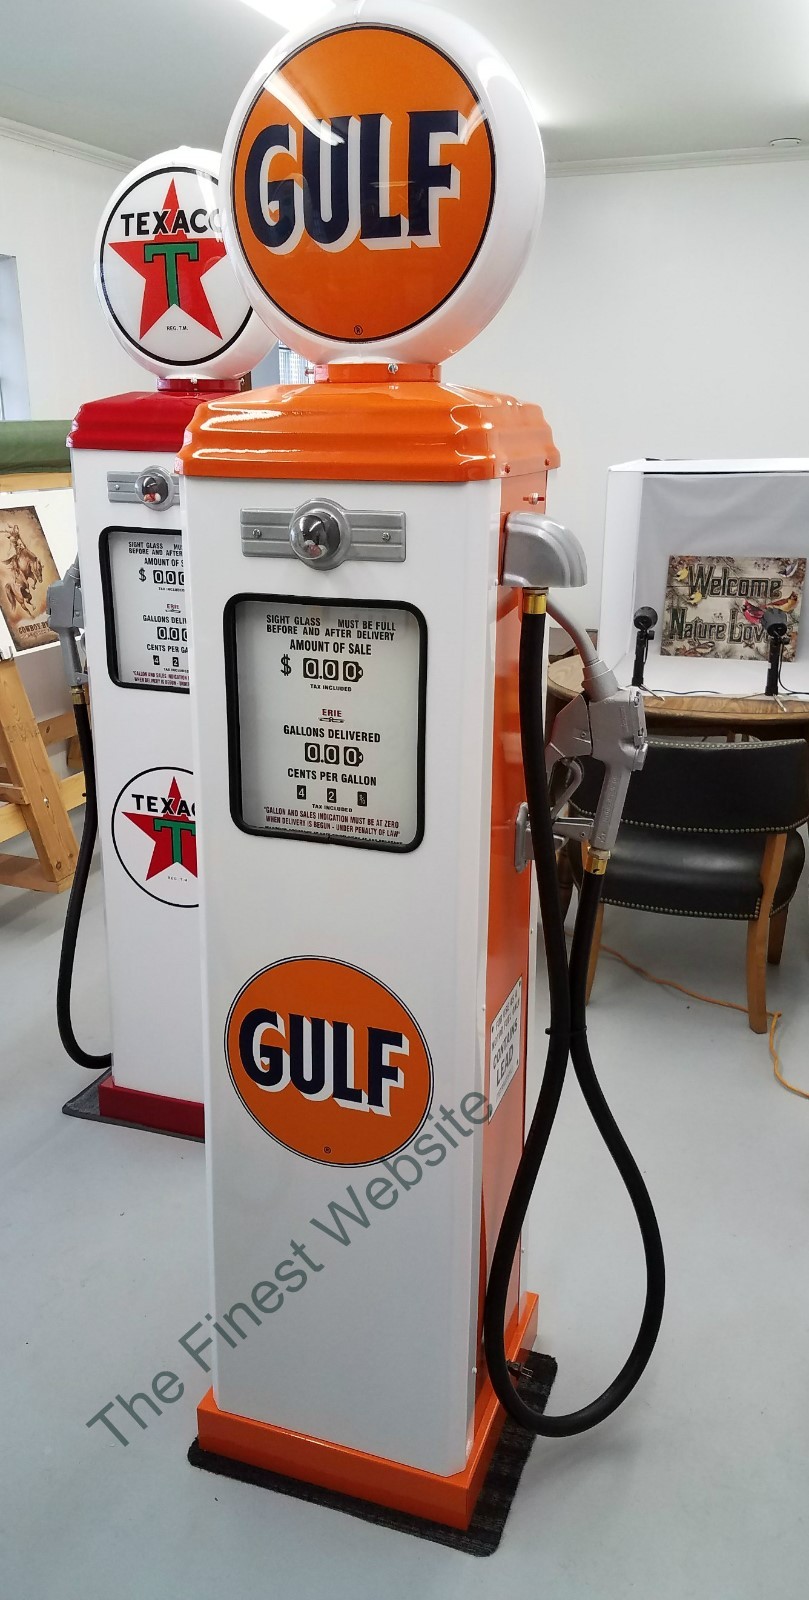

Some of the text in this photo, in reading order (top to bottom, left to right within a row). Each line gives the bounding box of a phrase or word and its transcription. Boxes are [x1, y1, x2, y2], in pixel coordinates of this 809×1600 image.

[245, 110, 467, 255] GULF
[144, 558, 169, 566] AMOUNT
[139, 567, 146, 582] $
[688, 564, 784, 599] Welcome
[143, 615, 169, 623] GALLONS
[266, 614, 396, 631] SIGHT GLASS MUST BE FULL
[670, 607, 771, 644] Nature Lov
[267, 624, 395, 641] BEFORE AND AFTER DELIVERY
[147, 644, 166, 652] CENTS
[290, 639, 372, 655] AMOUNT OF SALE
[280, 654, 292, 676] $
[322, 708, 342, 718] ERIE
[284, 725, 381, 743] GALLONS DELIVERED
[288, 768, 377, 786] CENTS PER GALLON
[298, 786, 335, 802] 4 2
[266, 815, 280, 824] WHEN
[282, 816, 306, 827] DELIVERY
[307, 819, 312, 827] IS
[314, 820, 331, 830] BEGUN
[336, 823, 354, 833] UNDER
[355, 826, 377, 835] PENALTY
[288, 809, 298, 817] AND
[300, 810, 316, 819] SALES
[318, 812, 348, 823] INDICATION
[350, 816, 365, 825] MUST
[384, 820, 399, 828] ZERO
[493, 1018, 517, 1070] CONTAINS
[239, 1008, 409, 1117] GULF
[496, 1044, 514, 1086] LEAD
